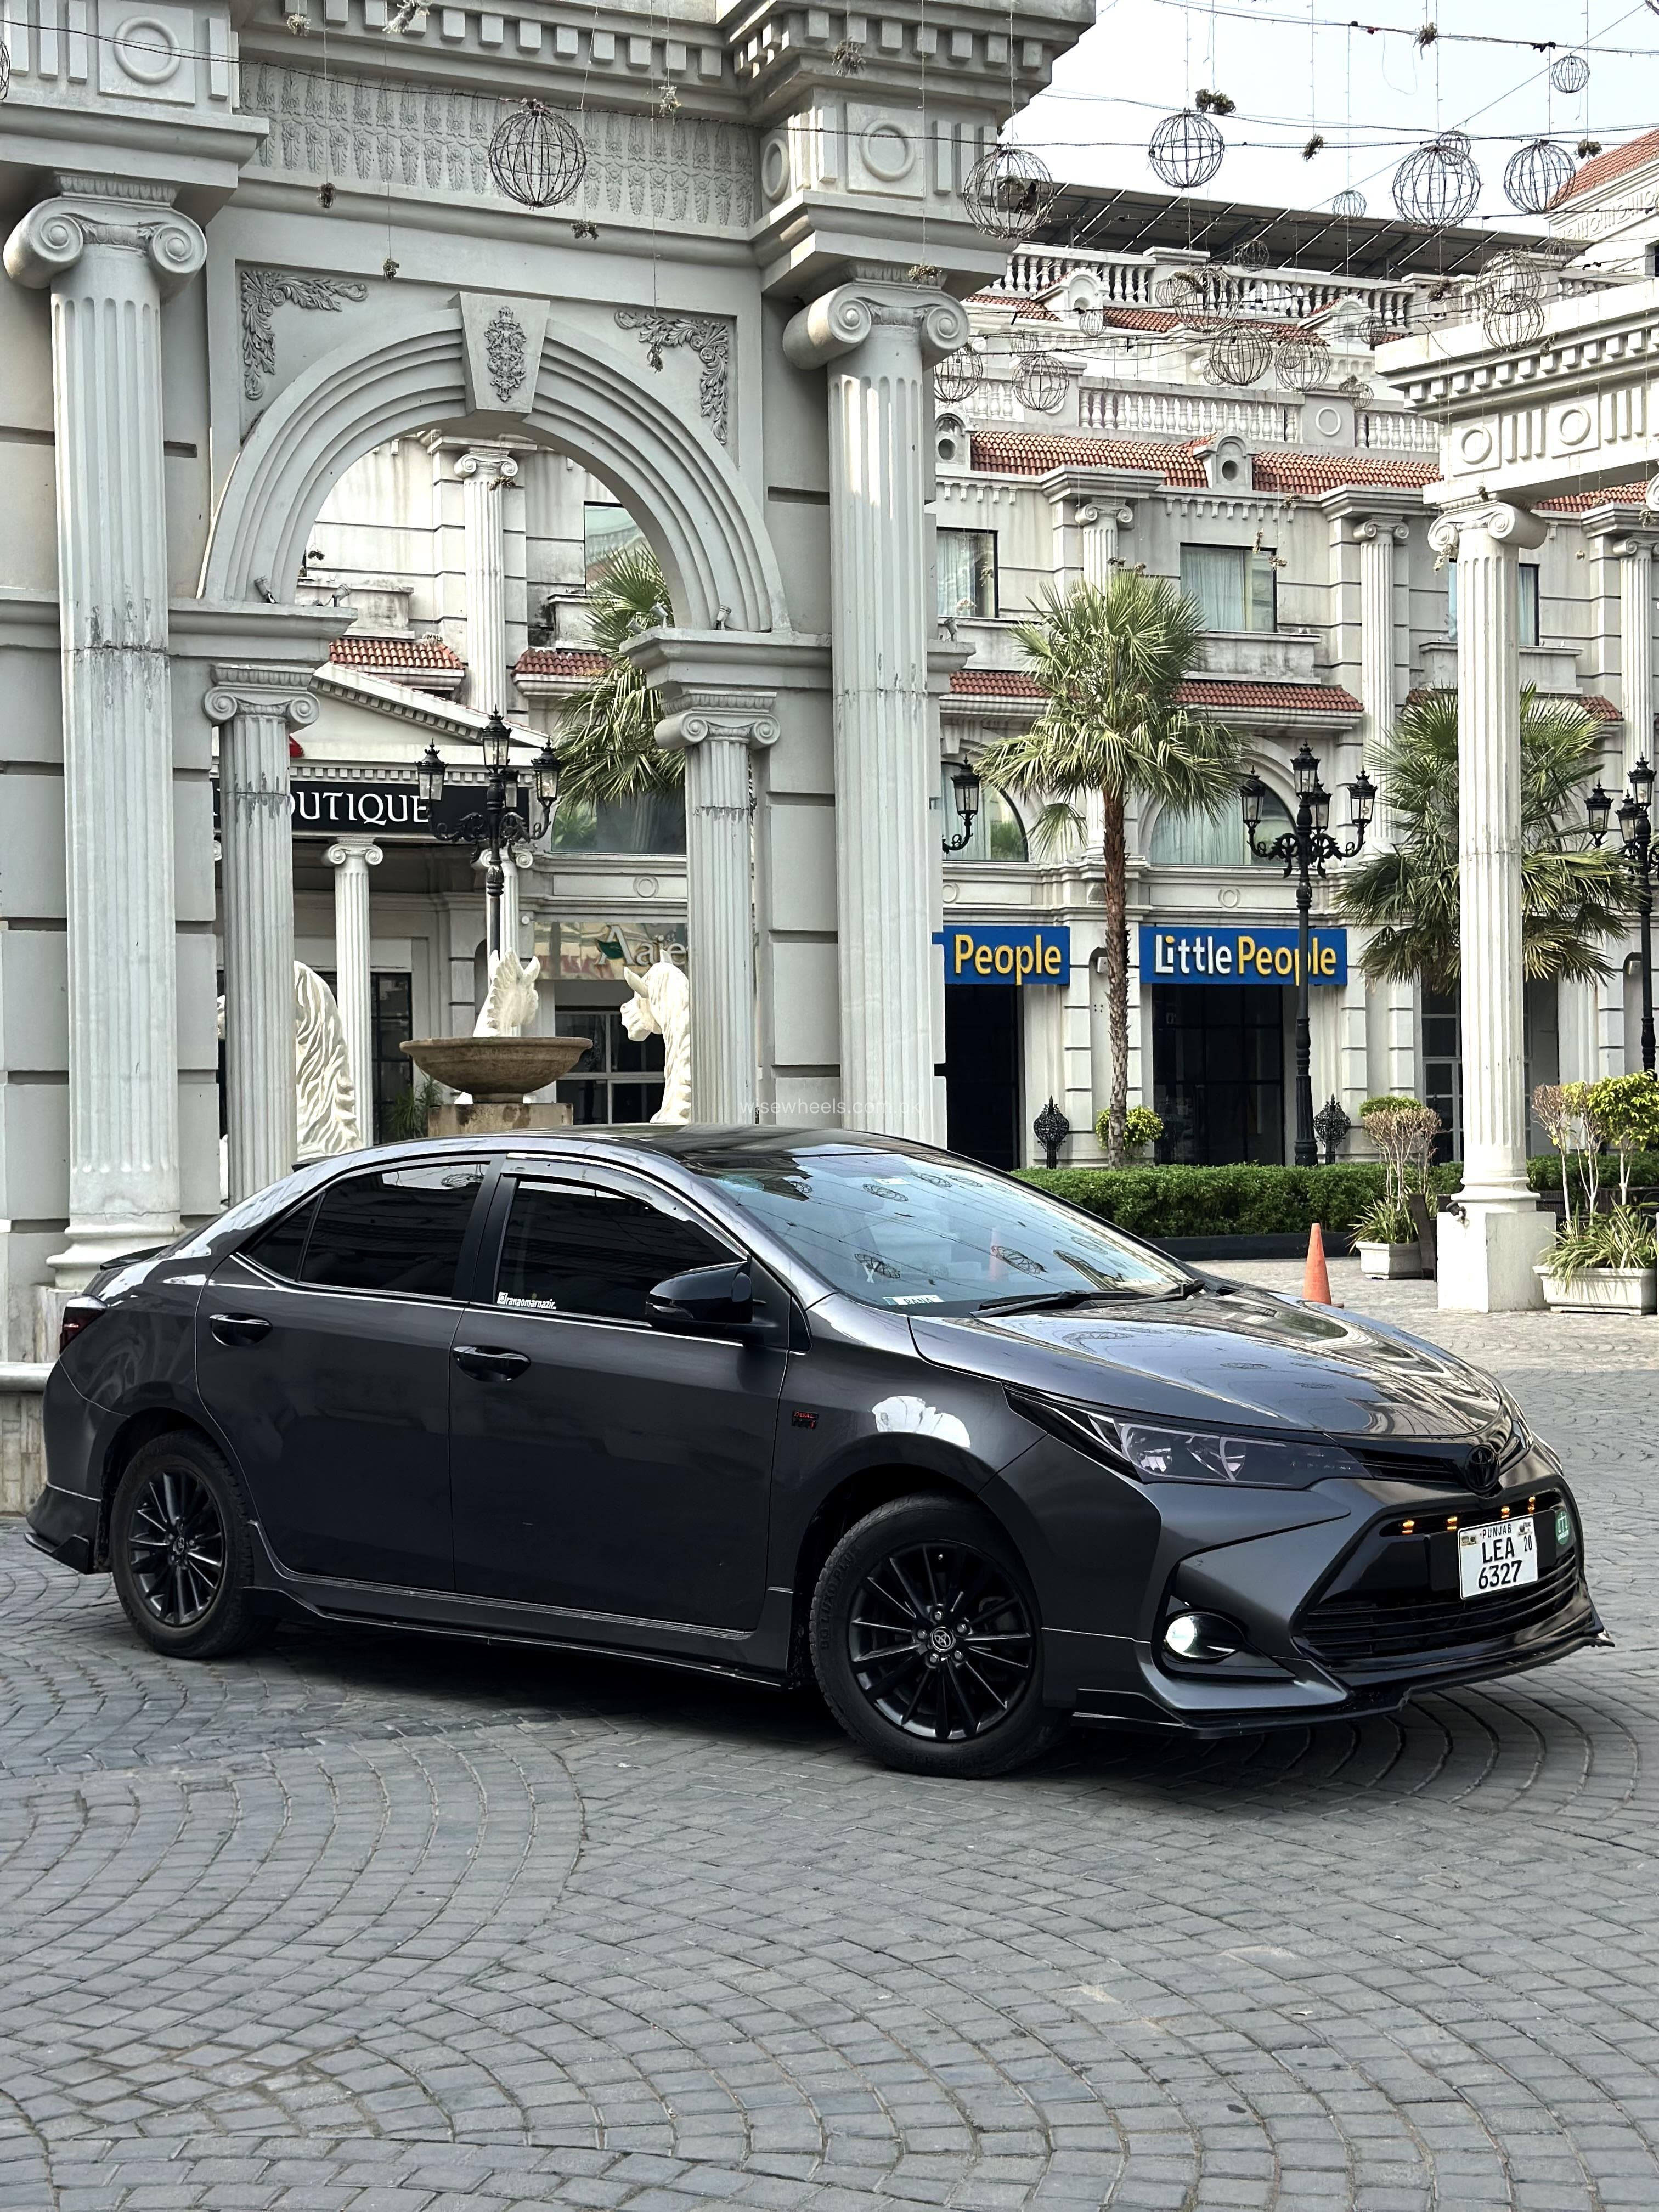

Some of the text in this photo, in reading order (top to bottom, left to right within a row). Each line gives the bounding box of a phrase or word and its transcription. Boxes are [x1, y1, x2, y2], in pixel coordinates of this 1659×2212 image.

[290, 792, 429, 826] UTIQUE
[954, 934, 1062, 985] People
[1154, 934, 1232, 975] Little
[1482, 1524, 1511, 1538] PUNJAB
[1523, 1535, 1532, 1551] 20
[1482, 1537, 1515, 1563] LEA
[1479, 1560, 1522, 1589] 6327
